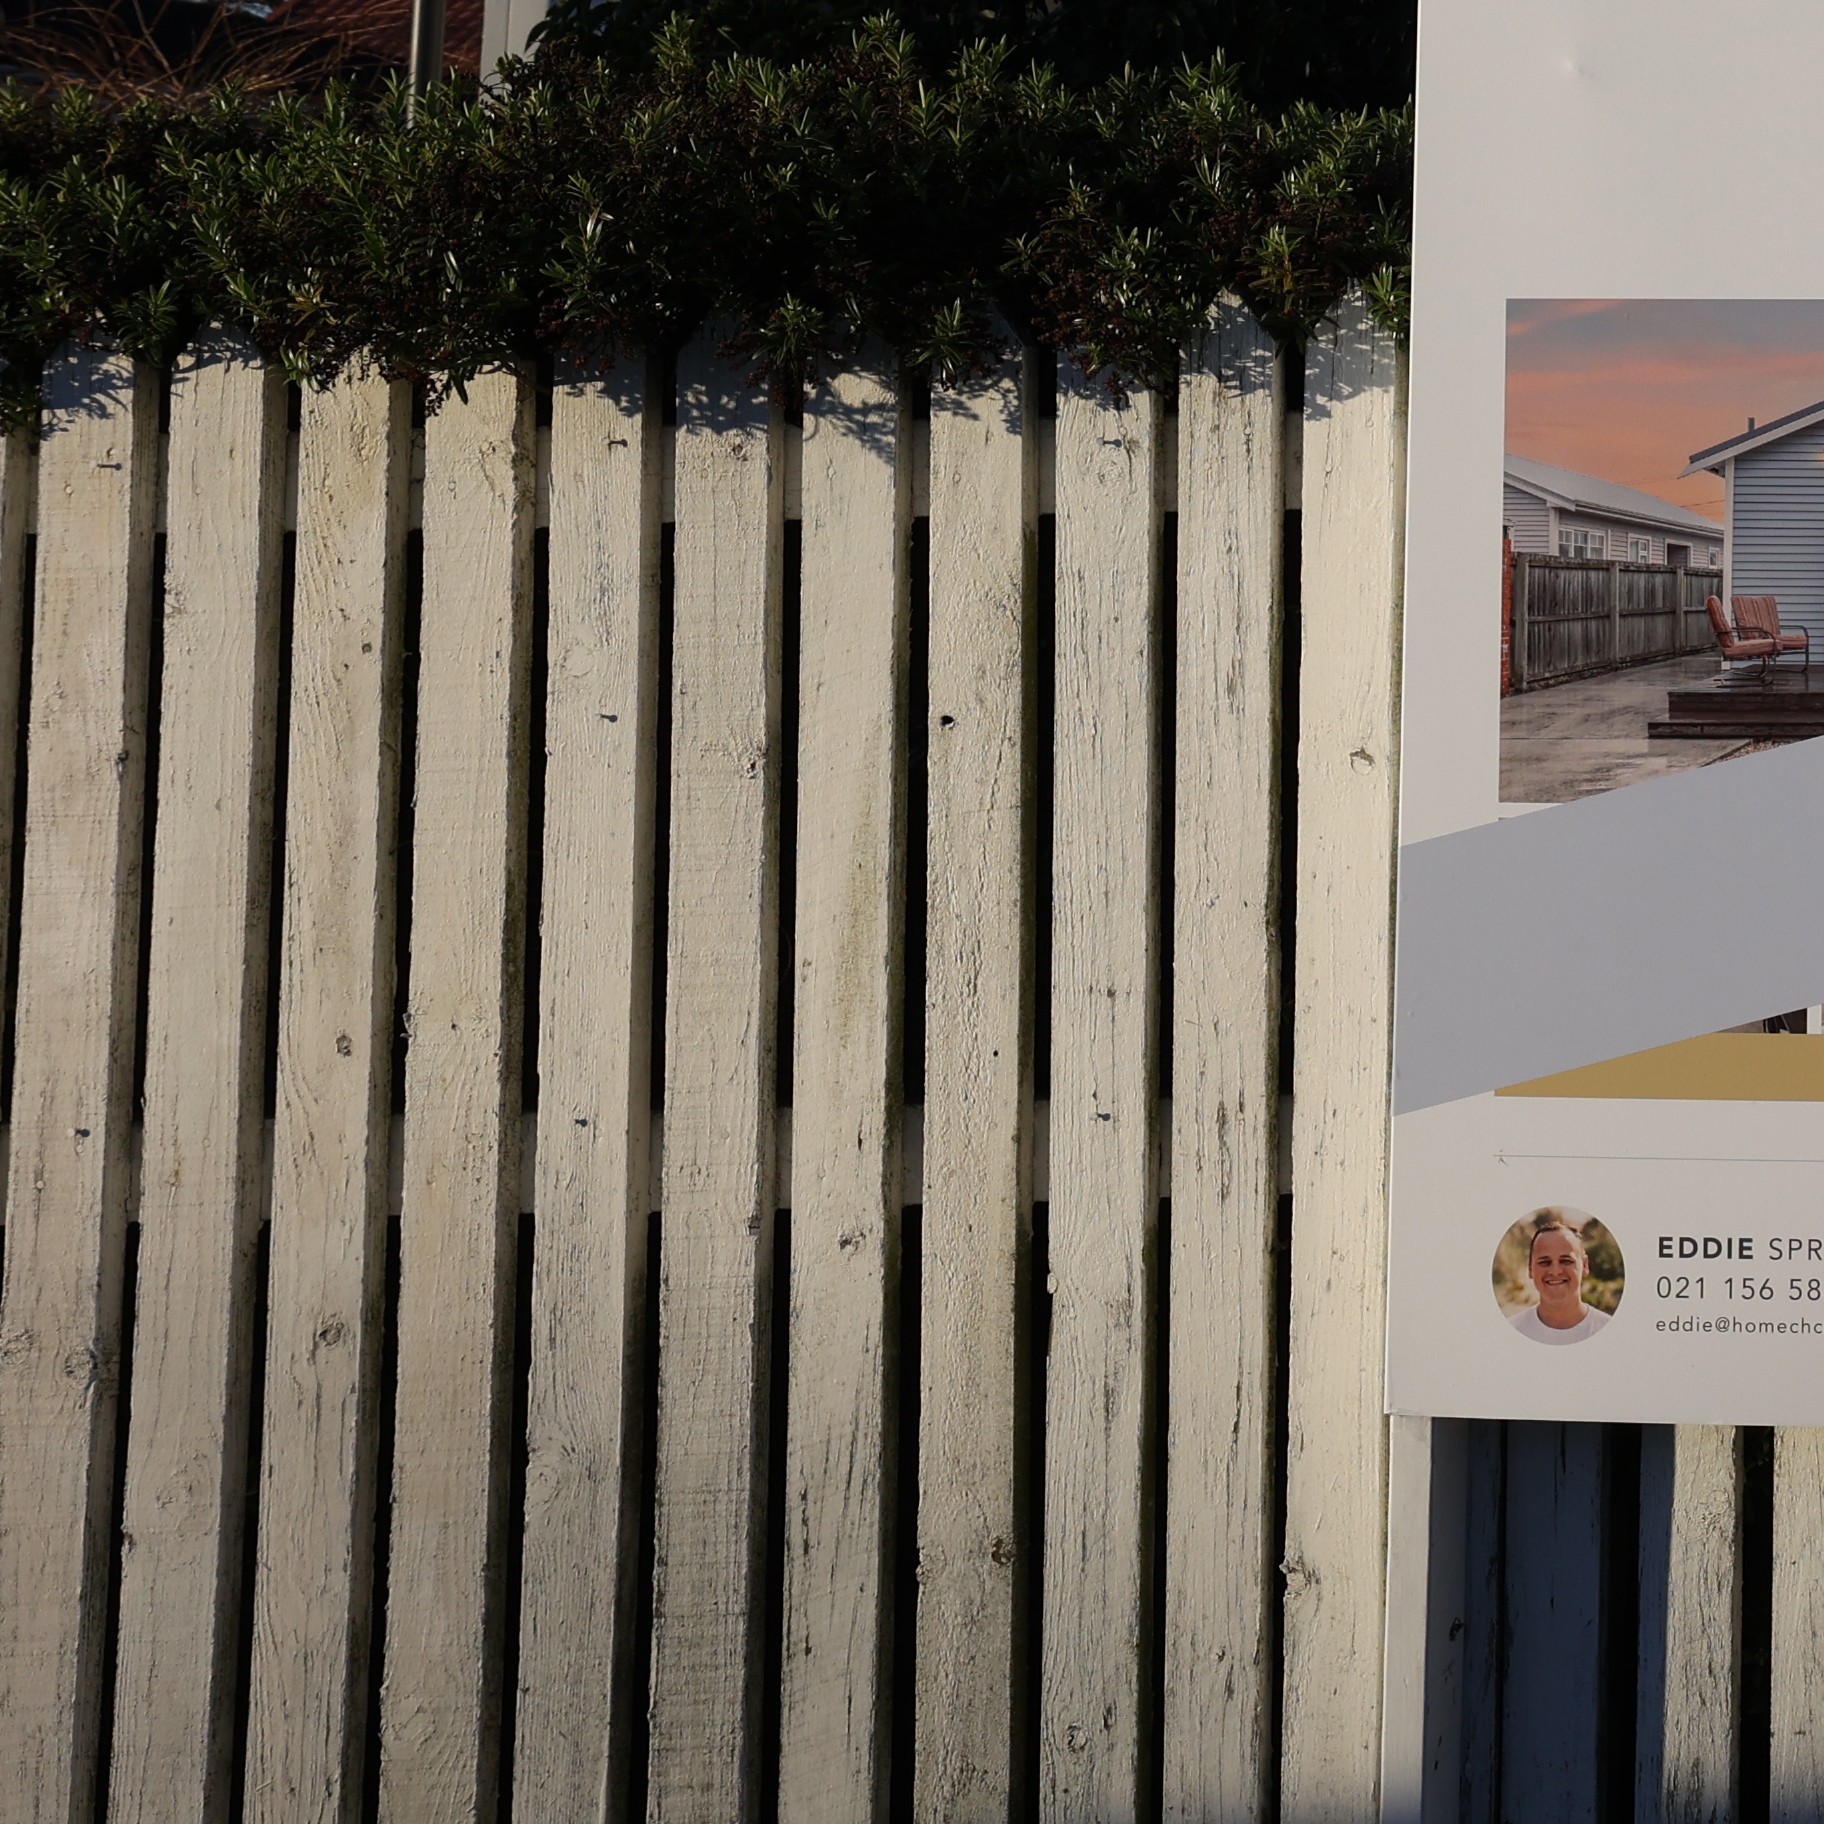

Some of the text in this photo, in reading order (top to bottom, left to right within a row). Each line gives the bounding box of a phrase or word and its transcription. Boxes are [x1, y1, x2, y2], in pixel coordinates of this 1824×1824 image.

[1658, 1236, 1754, 1259] EDDIE
[1656, 1276, 1706, 1299] 021
[1724, 1277, 1774, 1300] 156
